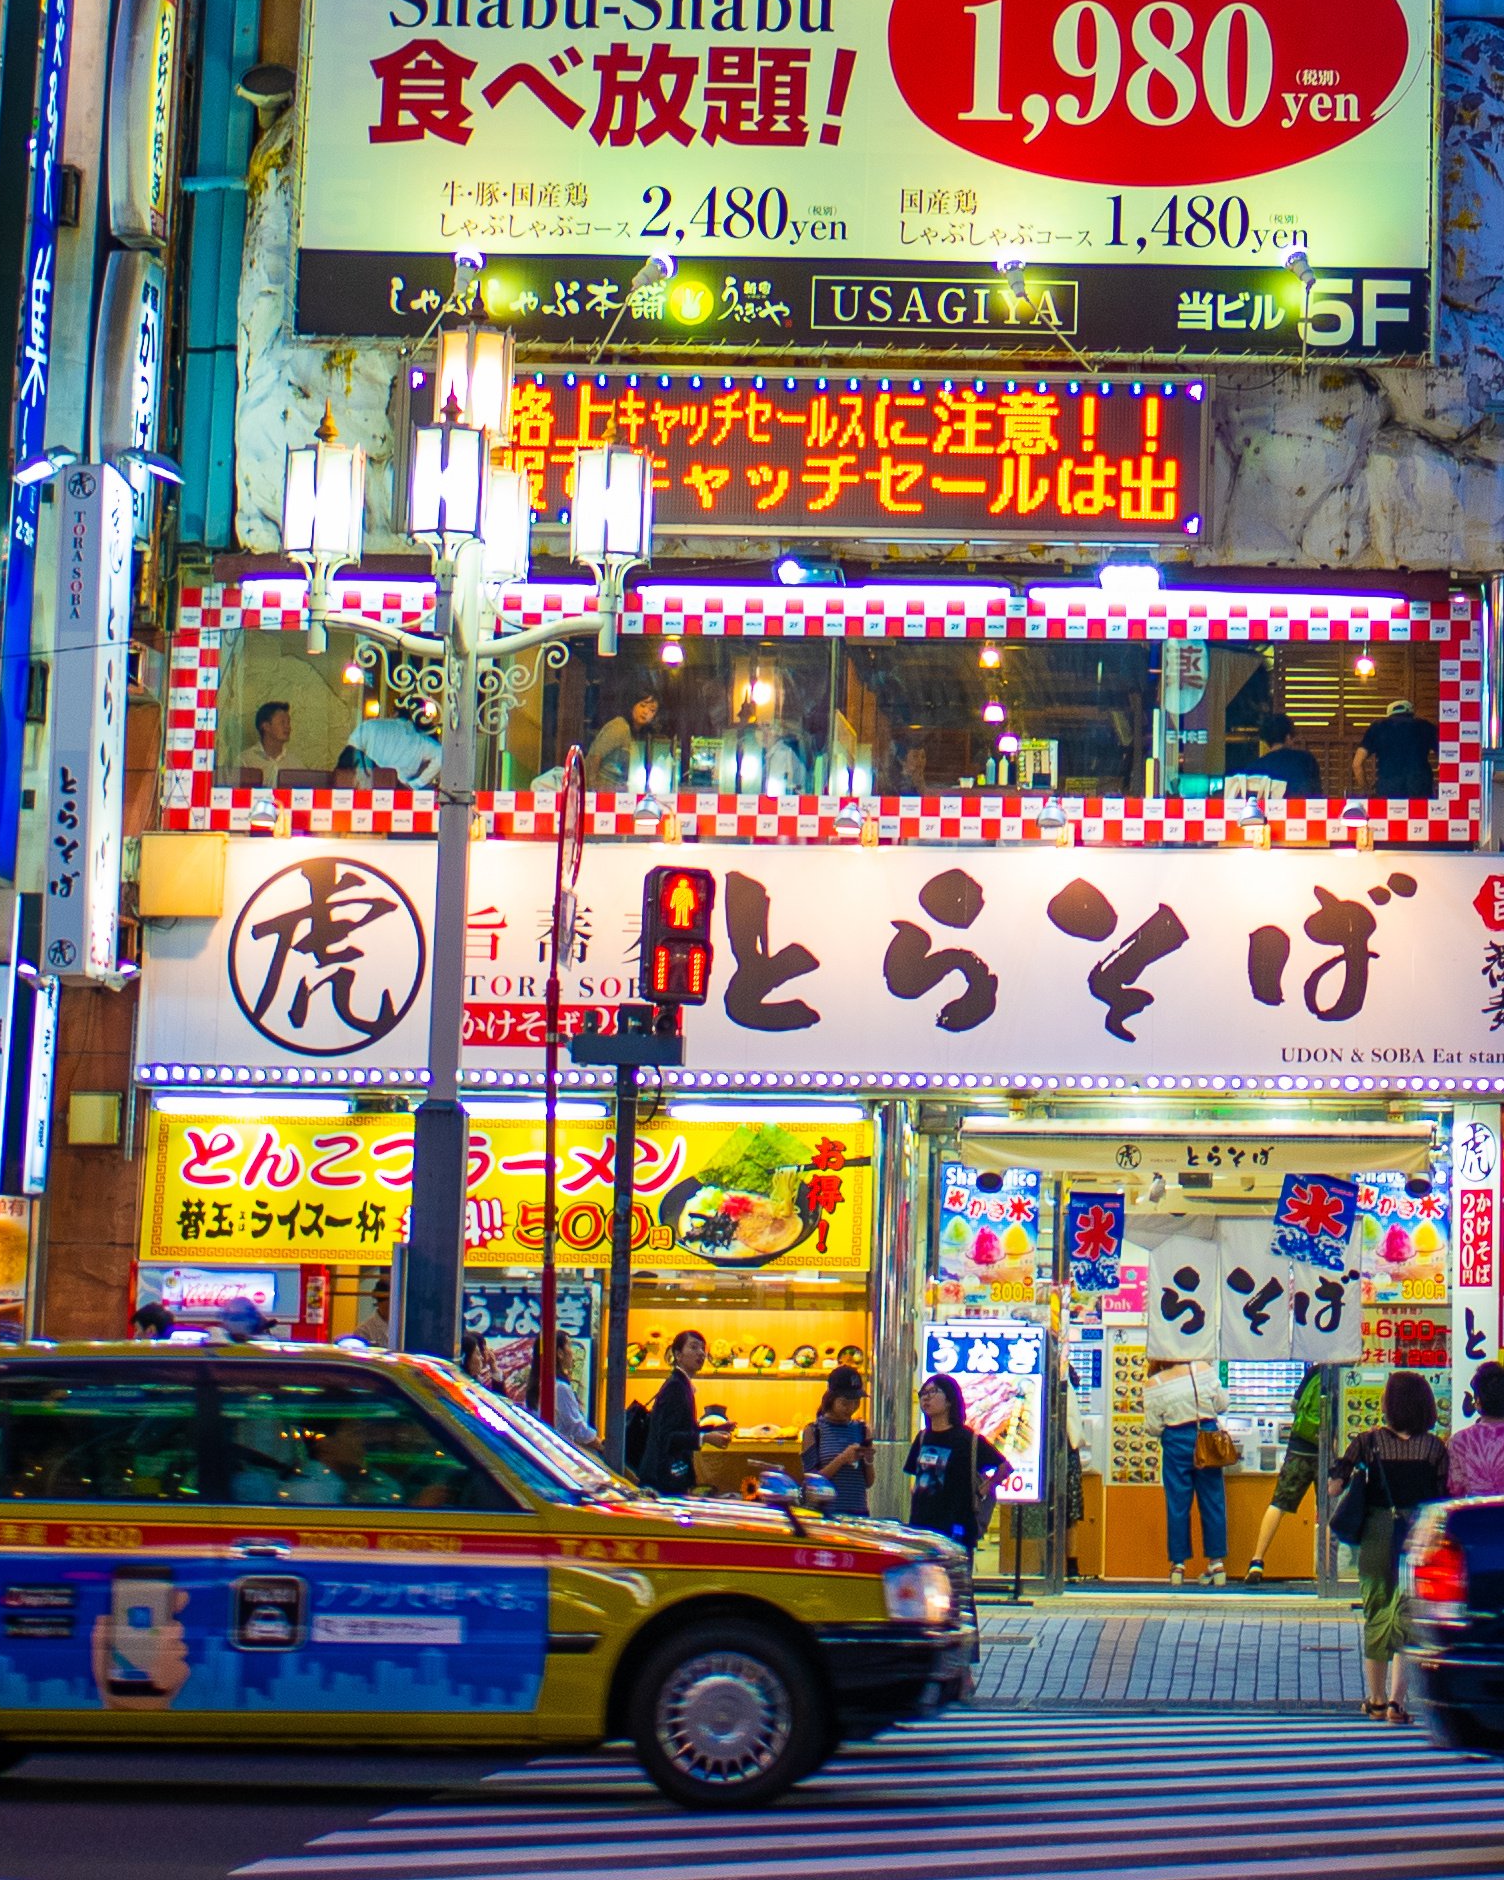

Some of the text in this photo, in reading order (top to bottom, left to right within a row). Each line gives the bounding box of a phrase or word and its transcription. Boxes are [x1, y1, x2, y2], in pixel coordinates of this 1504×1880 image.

[956, 0, 1363, 142] 1,980 yen
[638, 184, 849, 252] 2,480 yen
[898, 188, 979, 218] 国産鶏
[437, 210, 633, 241] しゃぶしゃぶコース
[898, 218, 1095, 250] しゃぶしゃぶコース
[1102, 194, 1311, 258] 1,480 yen
[829, 286, 1066, 328] USAGIYA
[1175, 277, 1423, 349] 当ビル 5F
[251, 856, 400, 1040] 虎
[723, 867, 1419, 1043] とらそば
[1280, 1047, 1345, 1065] UDON
[1350, 1048, 1367, 1065] &
[1370, 1048, 1427, 1066] SOBA
[1432, 1049, 1465, 1066] Eat
[990, 1281, 1035, 1303] 300円
[932, 1338, 1041, 1373] うなぎ
[558, 1537, 662, 1562] TAXI
